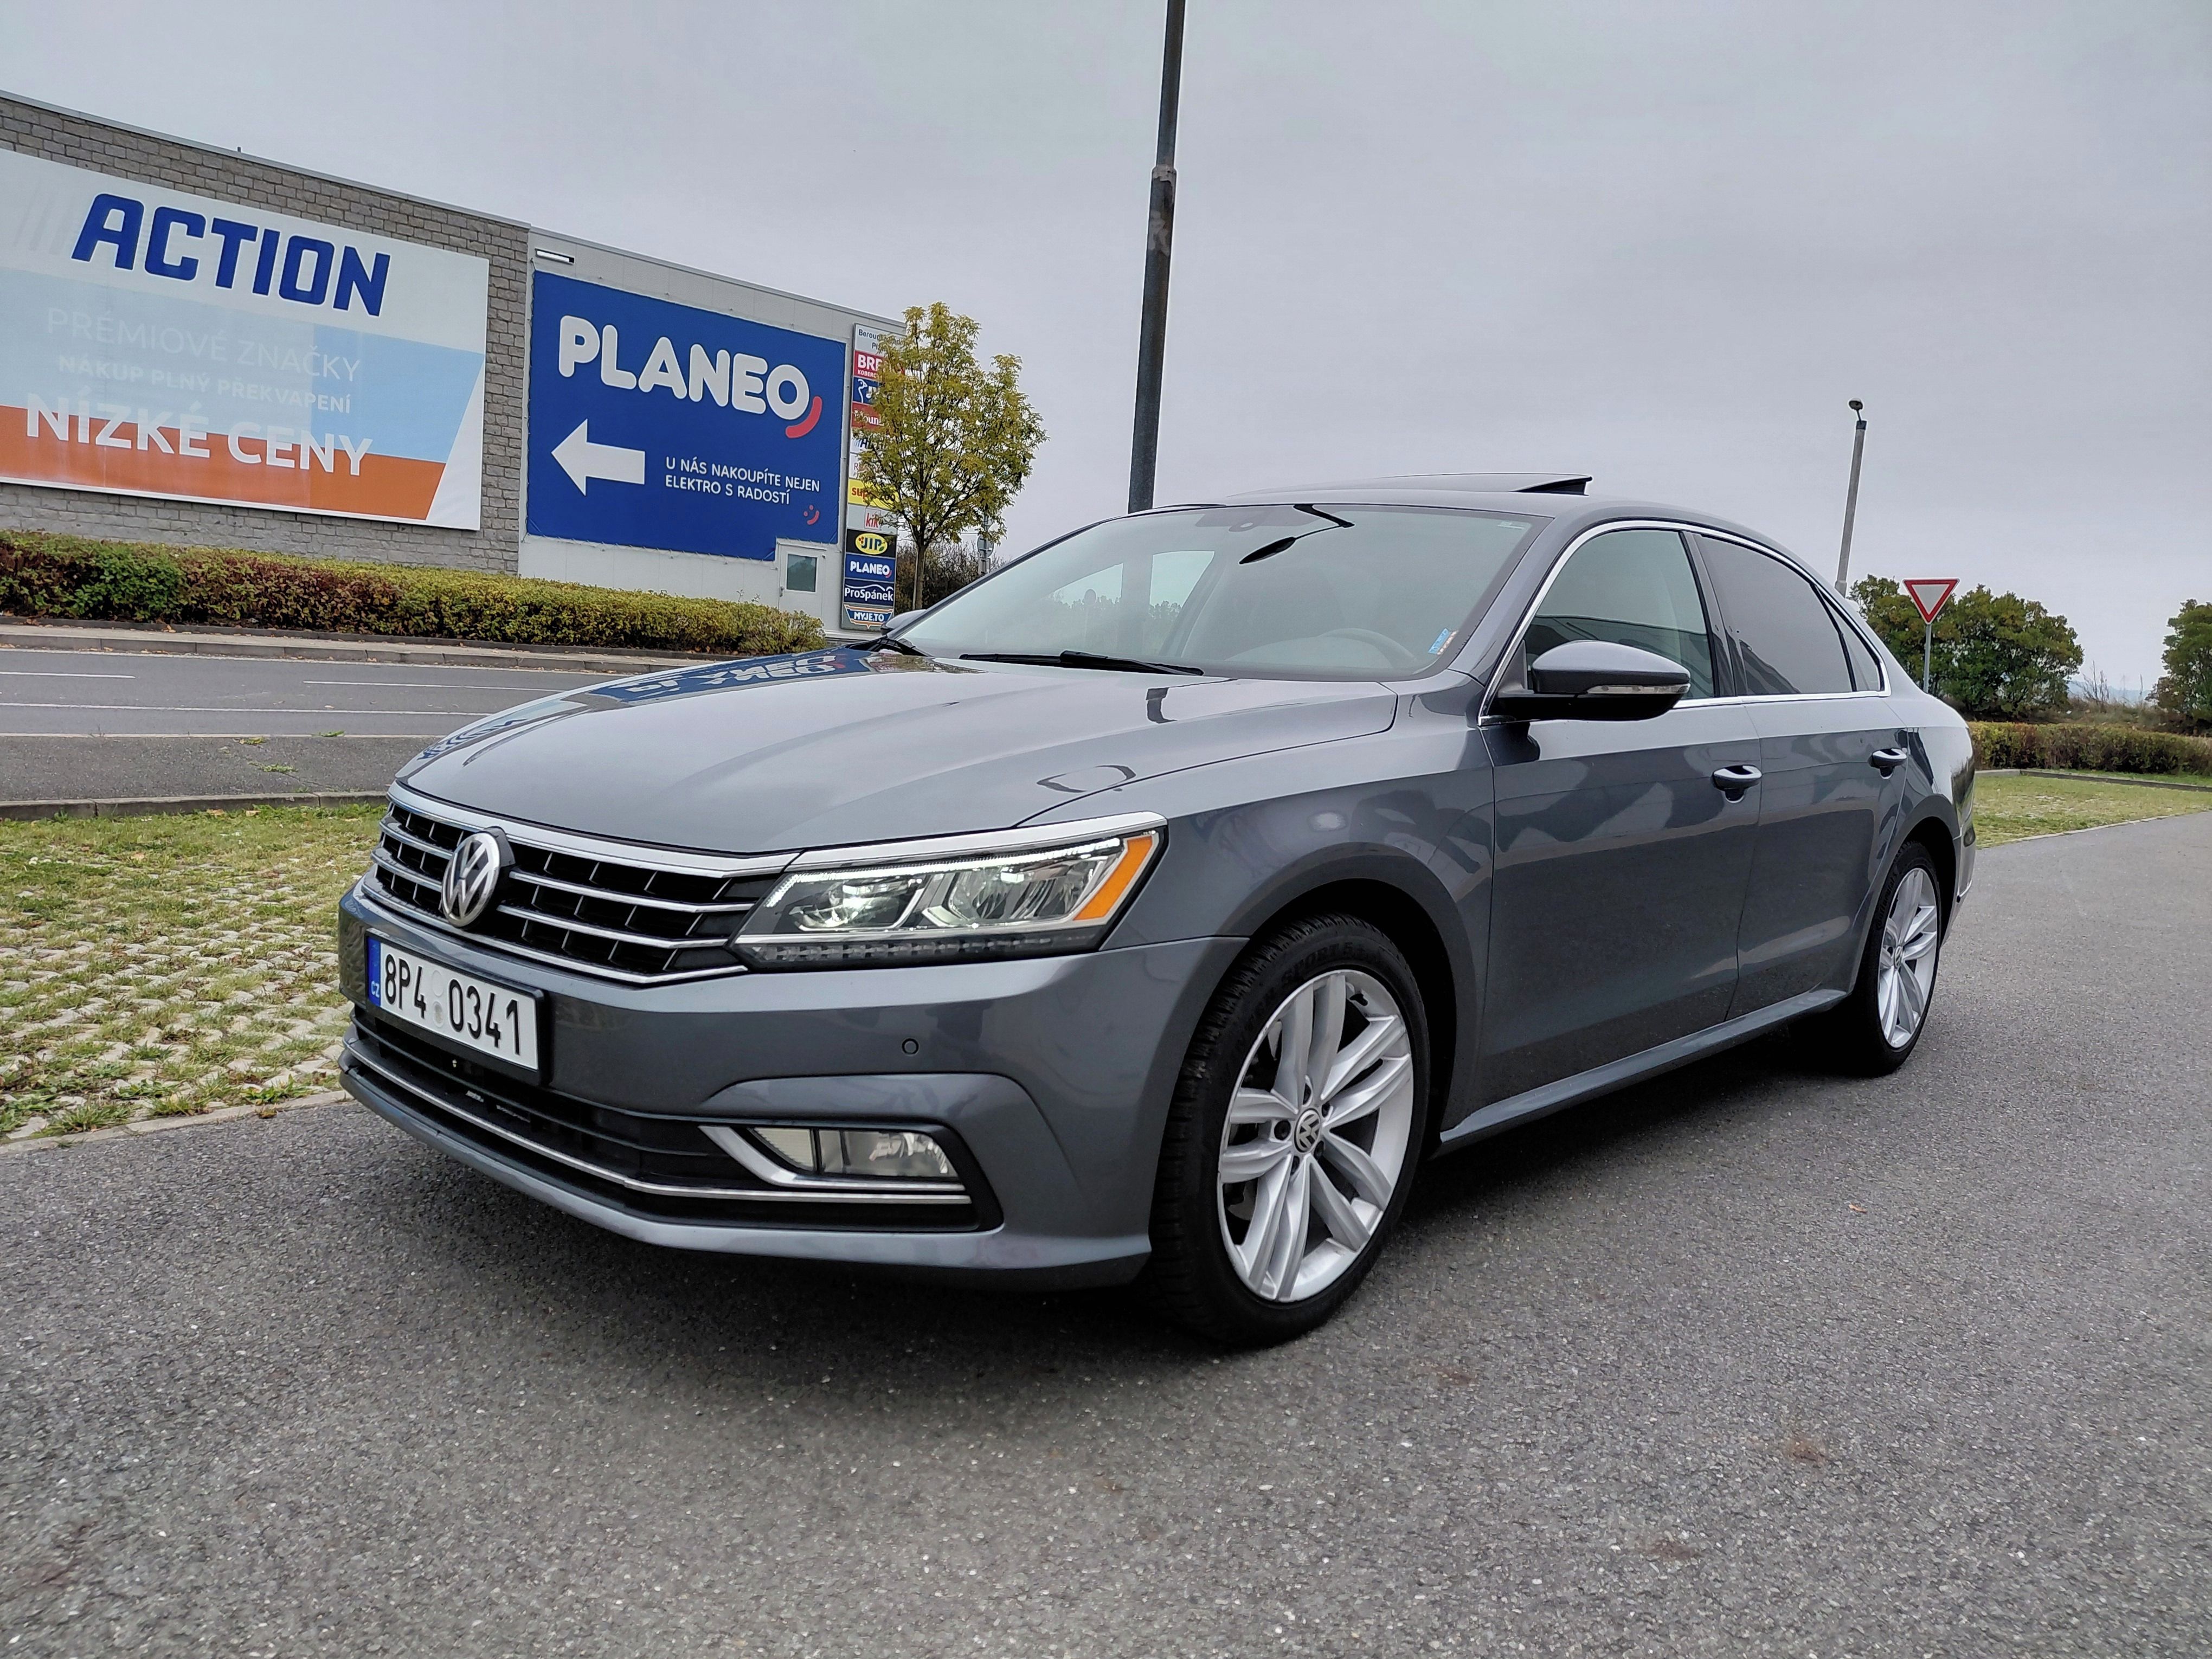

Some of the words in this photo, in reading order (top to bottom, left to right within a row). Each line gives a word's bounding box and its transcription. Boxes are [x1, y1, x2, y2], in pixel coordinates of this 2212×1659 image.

[72, 194, 390, 316] ACTION
[48, 307, 227, 363] PRÉMIOVÉ
[238, 339, 361, 383] ZNAČKY
[59, 355, 144, 382] NÁKUP
[152, 369, 211, 393] PLNÝ
[218, 377, 351, 414] PŘEKVAPENÍ
[559, 315, 809, 420] PLANEO
[27, 385, 211, 459] NÍZKÉ
[227, 421, 374, 477] CENY
[666, 456, 676, 470] U
[680, 456, 707, 474] NÁS
[711, 464, 781, 486] NAKOUPÍTE
[785, 476, 820, 492] NEJEN
[666, 474, 721, 494] ELEKTRO
[725, 484, 733, 496] S
[738, 488, 790, 505] RADOSTÍ
[861, 537, 883, 550] JIP
[850, 561, 890, 575] PLANEO
[844, 587, 893, 601] ProSpánek
[854, 612, 884, 622] MYJE.TO
[371, 980, 380, 998] CZ
[385, 954, 426, 1019] 8P4
[449, 979, 520, 1056] 0341
